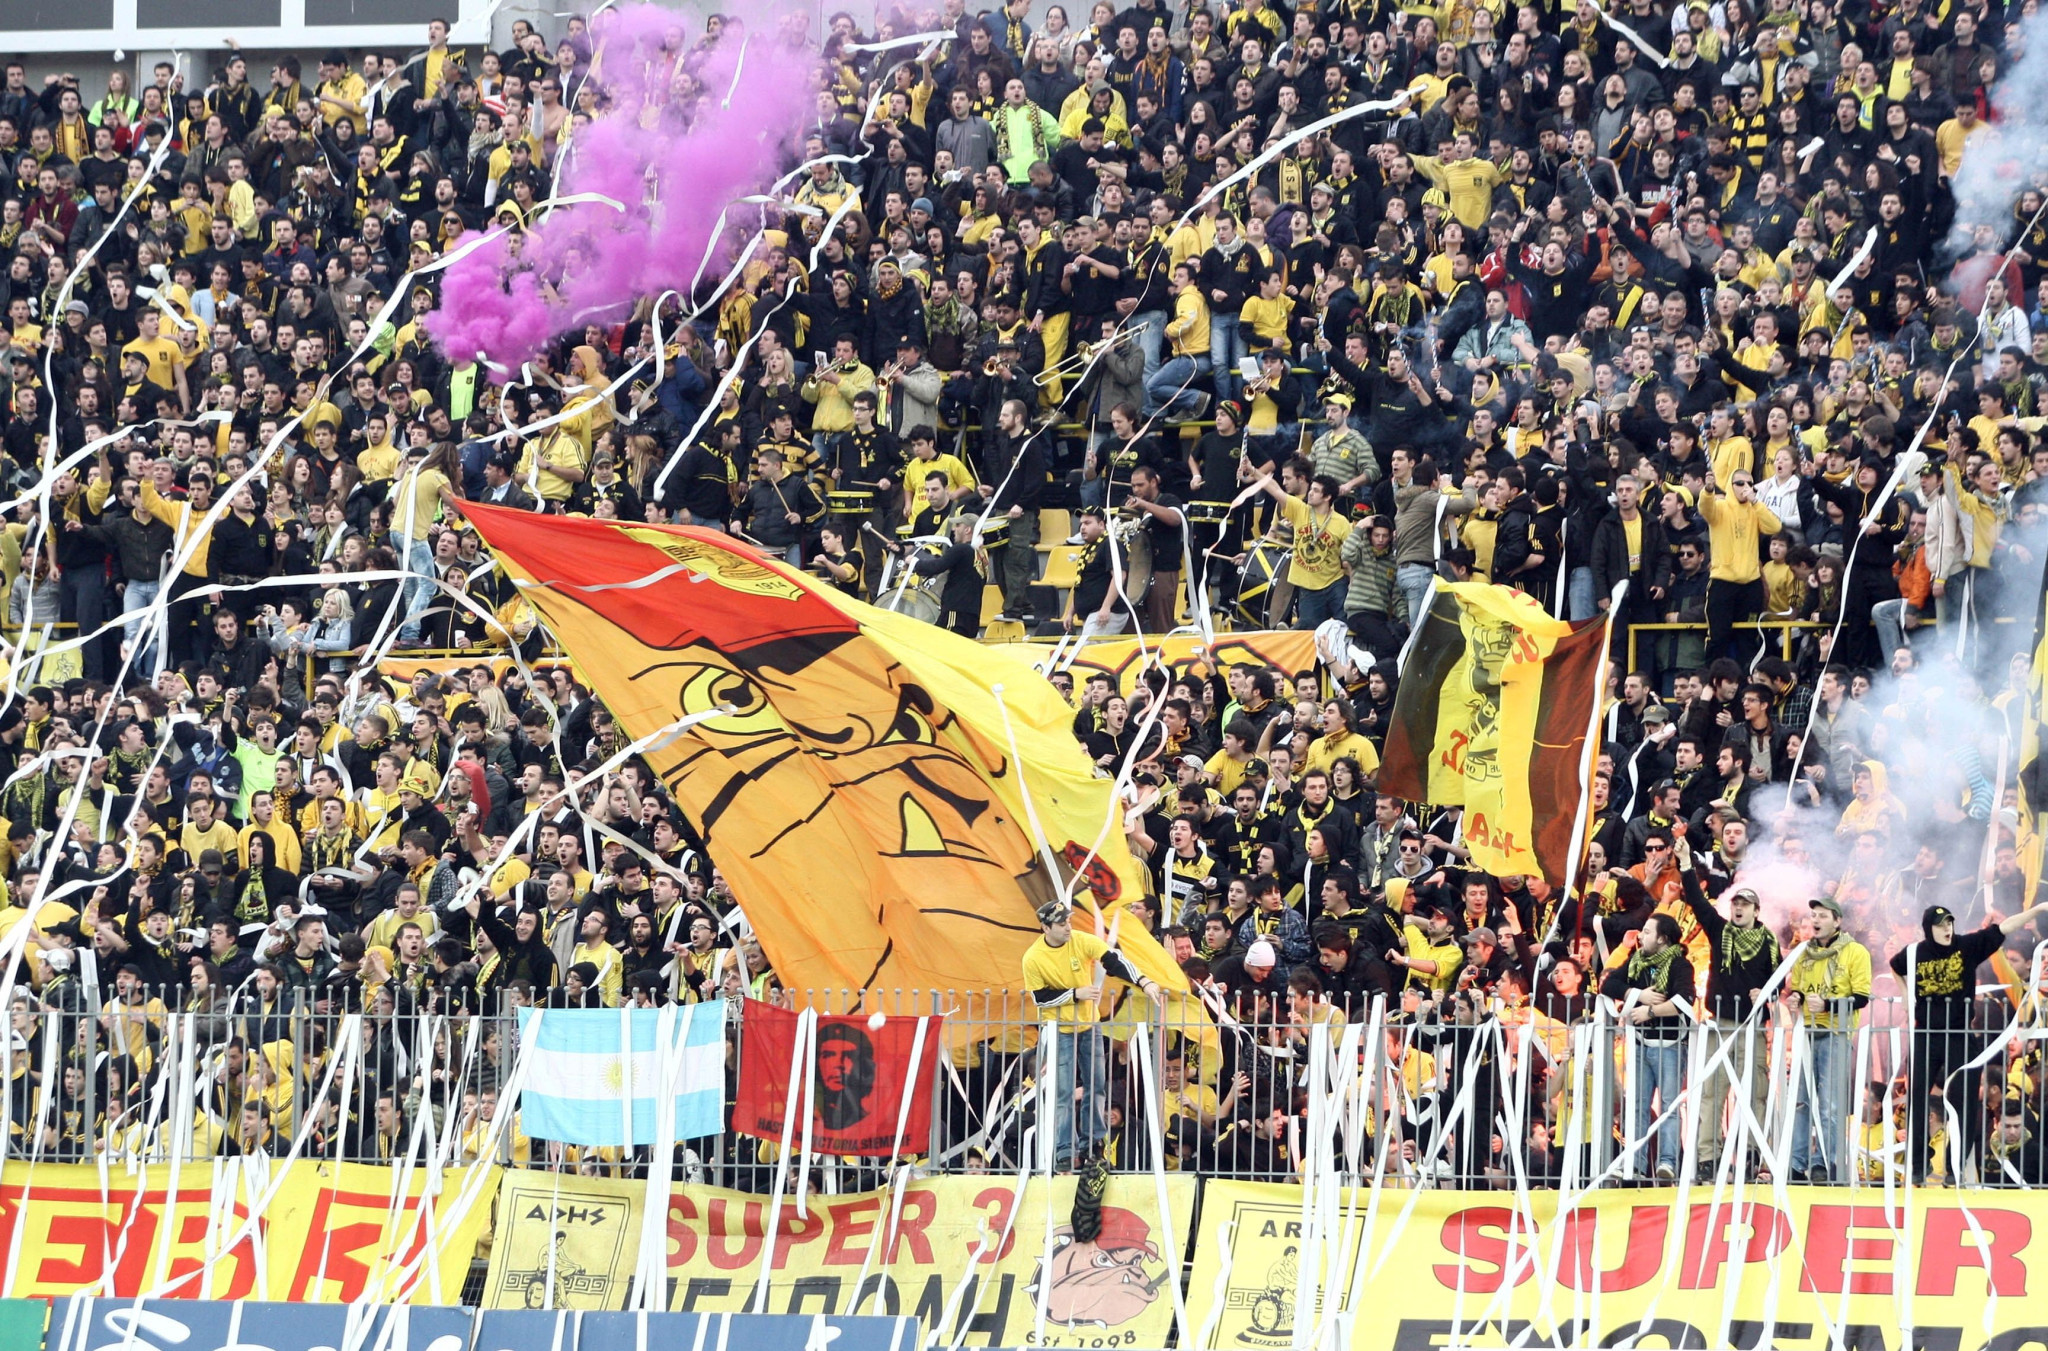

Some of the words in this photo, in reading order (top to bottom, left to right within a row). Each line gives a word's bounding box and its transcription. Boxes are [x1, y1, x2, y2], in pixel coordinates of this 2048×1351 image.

[755, 581, 788, 590] 1914
[811, 1135, 858, 1152] ICTORIA
[667, 1188, 938, 1270] SUPER
[966, 1187, 1016, 1265] 3
[1432, 1202, 2033, 1297] SUPER
